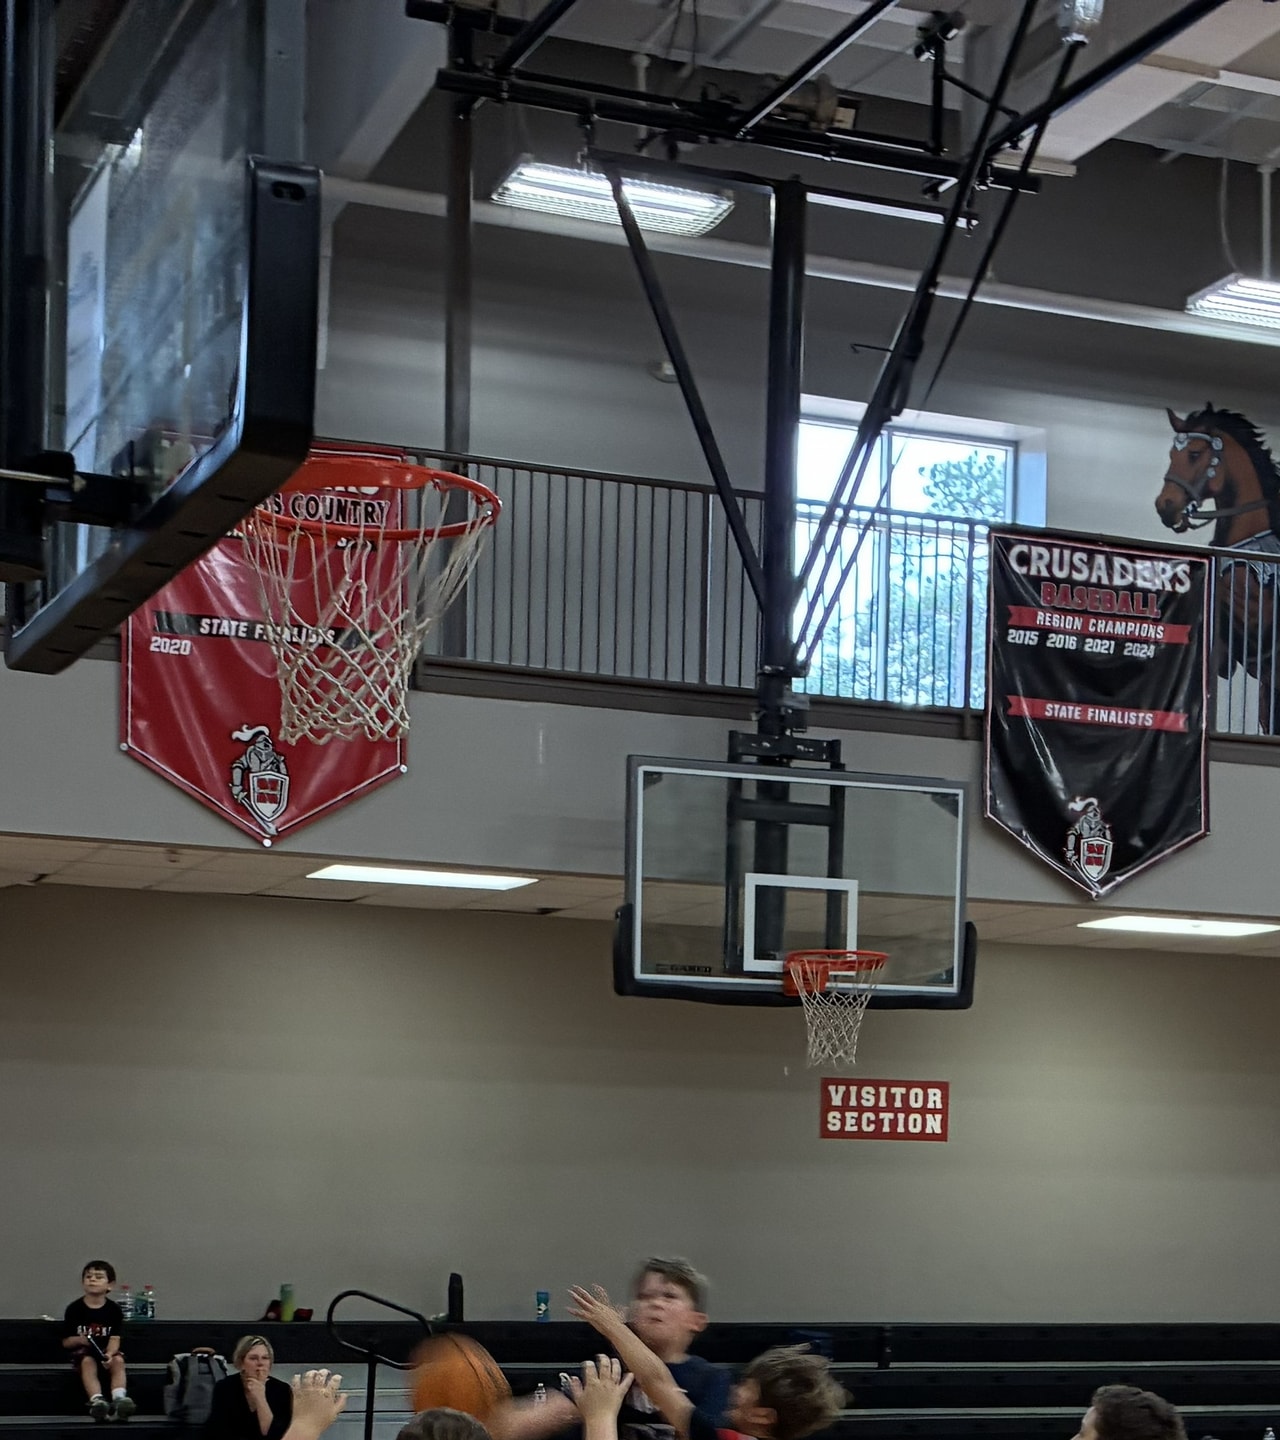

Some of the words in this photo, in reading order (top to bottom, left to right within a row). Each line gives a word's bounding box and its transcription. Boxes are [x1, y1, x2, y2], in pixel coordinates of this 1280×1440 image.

[290, 492, 391, 526] COUNTRY
[1008, 544, 1192, 594] CRUSADERS
[1040, 582, 1162, 619] BASEBALL
[200, 617, 248, 638] STATE
[255, 623, 336, 645] FALISS
[1036, 611, 1083, 632] REGION
[1088, 618, 1165, 640] CHAMPIONS
[150, 636, 192, 656] 2020
[1007, 629, 1039, 646] 2015
[1046, 633, 1077, 650] 2016
[1084, 638, 1115, 655] 2021
[1123, 642, 1155, 659] 2024
[1045, 703, 1081, 720] STATE
[1087, 708, 1154, 727] FINALISTS
[827, 1084, 943, 1109] VISITOR
[827, 1111, 942, 1134] SECTION
